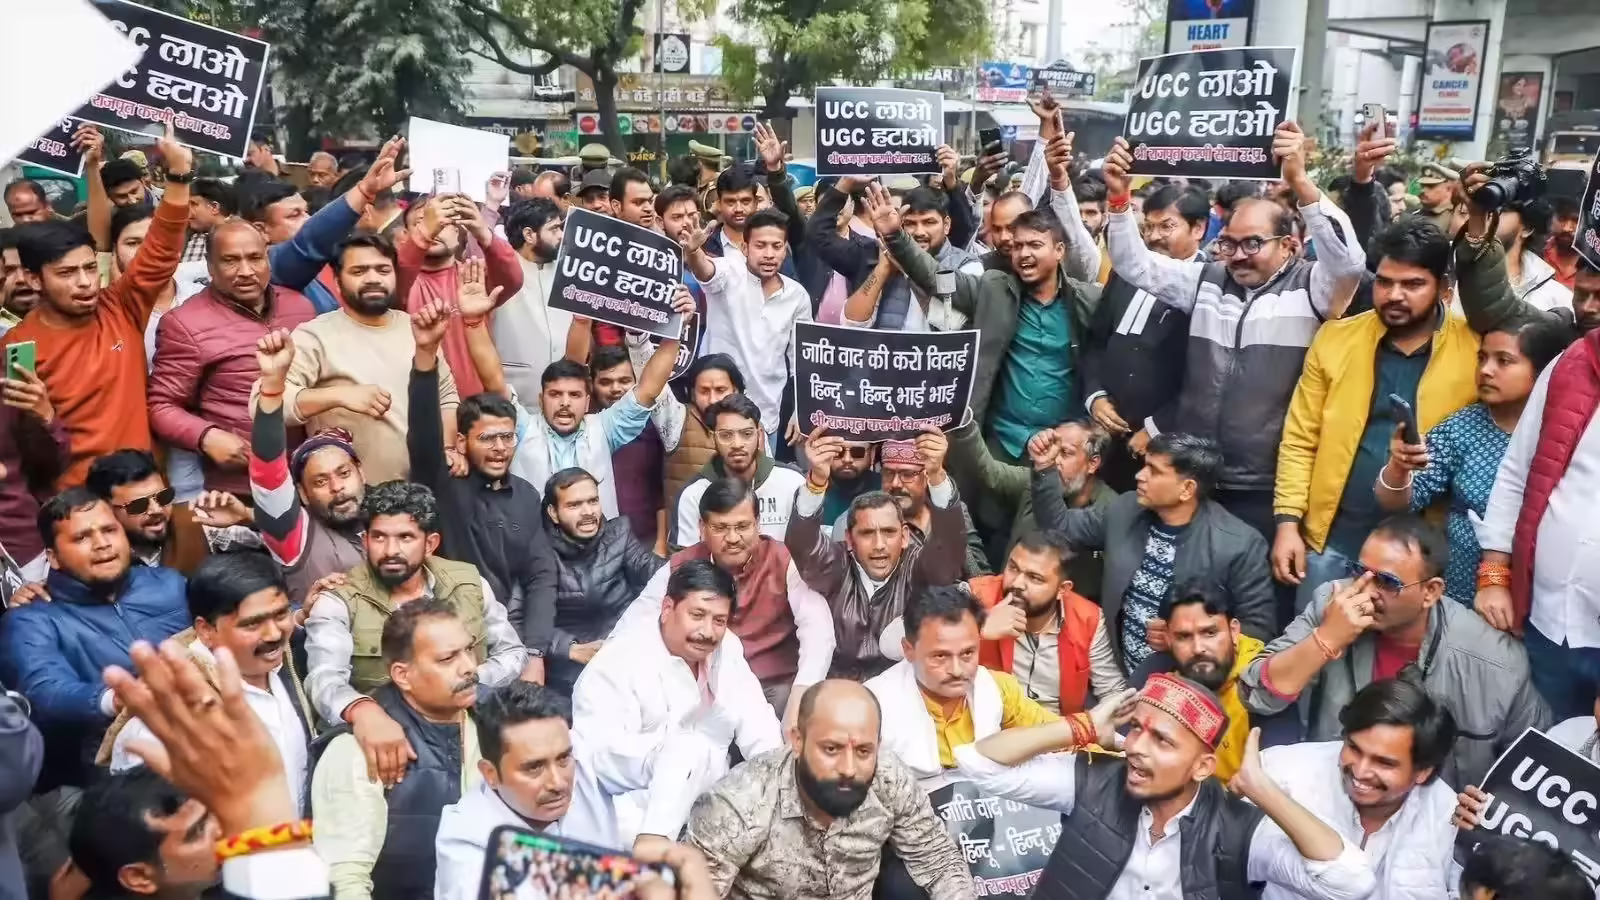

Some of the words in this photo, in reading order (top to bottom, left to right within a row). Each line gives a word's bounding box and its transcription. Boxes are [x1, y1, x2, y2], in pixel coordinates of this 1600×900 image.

[1187, 24, 1230, 40] HEART
[159, 34, 250, 82] लाओ
[911, 68, 952, 81] WEAR
[147, 70, 249, 119] हटाओ
[1141, 72, 1190, 99] UCC
[1198, 60, 1278, 98] लाओ
[92, 94, 137, 119] राजपूत
[137, 104, 176, 126] करणी
[174, 111, 202, 132] सेना
[825, 101, 869, 119] UCC
[874, 98, 932, 121] लाओ
[1129, 110, 1181, 136] UGC
[1188, 101, 1280, 137] हटाओ
[821, 128, 866, 146] UGC
[871, 123, 937, 147] हटाओ
[1133, 143, 1147, 161] श्री
[1148, 147, 1182, 165] राजपूत
[1183, 143, 1212, 162] करणी
[1213, 144, 1240, 162] सेना
[574, 226, 622, 257] UCC
[626, 241, 679, 276] लाओ
[562, 256, 611, 286] UGC
[562, 284, 577, 300] श्री
[575, 289, 606, 310] राजपूत
[605, 297, 631, 316] करणी
[630, 302, 650, 319] सेना
[802, 338, 835, 365] जाति
[838, 346, 865, 369] वाद
[867, 344, 889, 370] की
[892, 346, 923, 371] करो
[926, 343, 969, 372] विदाई
[810, 373, 845, 410] हिन्दू
[859, 379, 896, 413] हिन्दू
[896, 380, 927, 409] भाई
[929, 377, 959, 405] भाई
[827, 416, 866, 435] राजपूत
[866, 415, 901, 432] करणी
[938, 794, 975, 822] जाति
[975, 796, 1003, 819] वाद
[1511, 756, 1597, 825] UCC
[959, 833, 1000, 869] हिन्दू
[1006, 826, 1053, 857] हिन्दू
